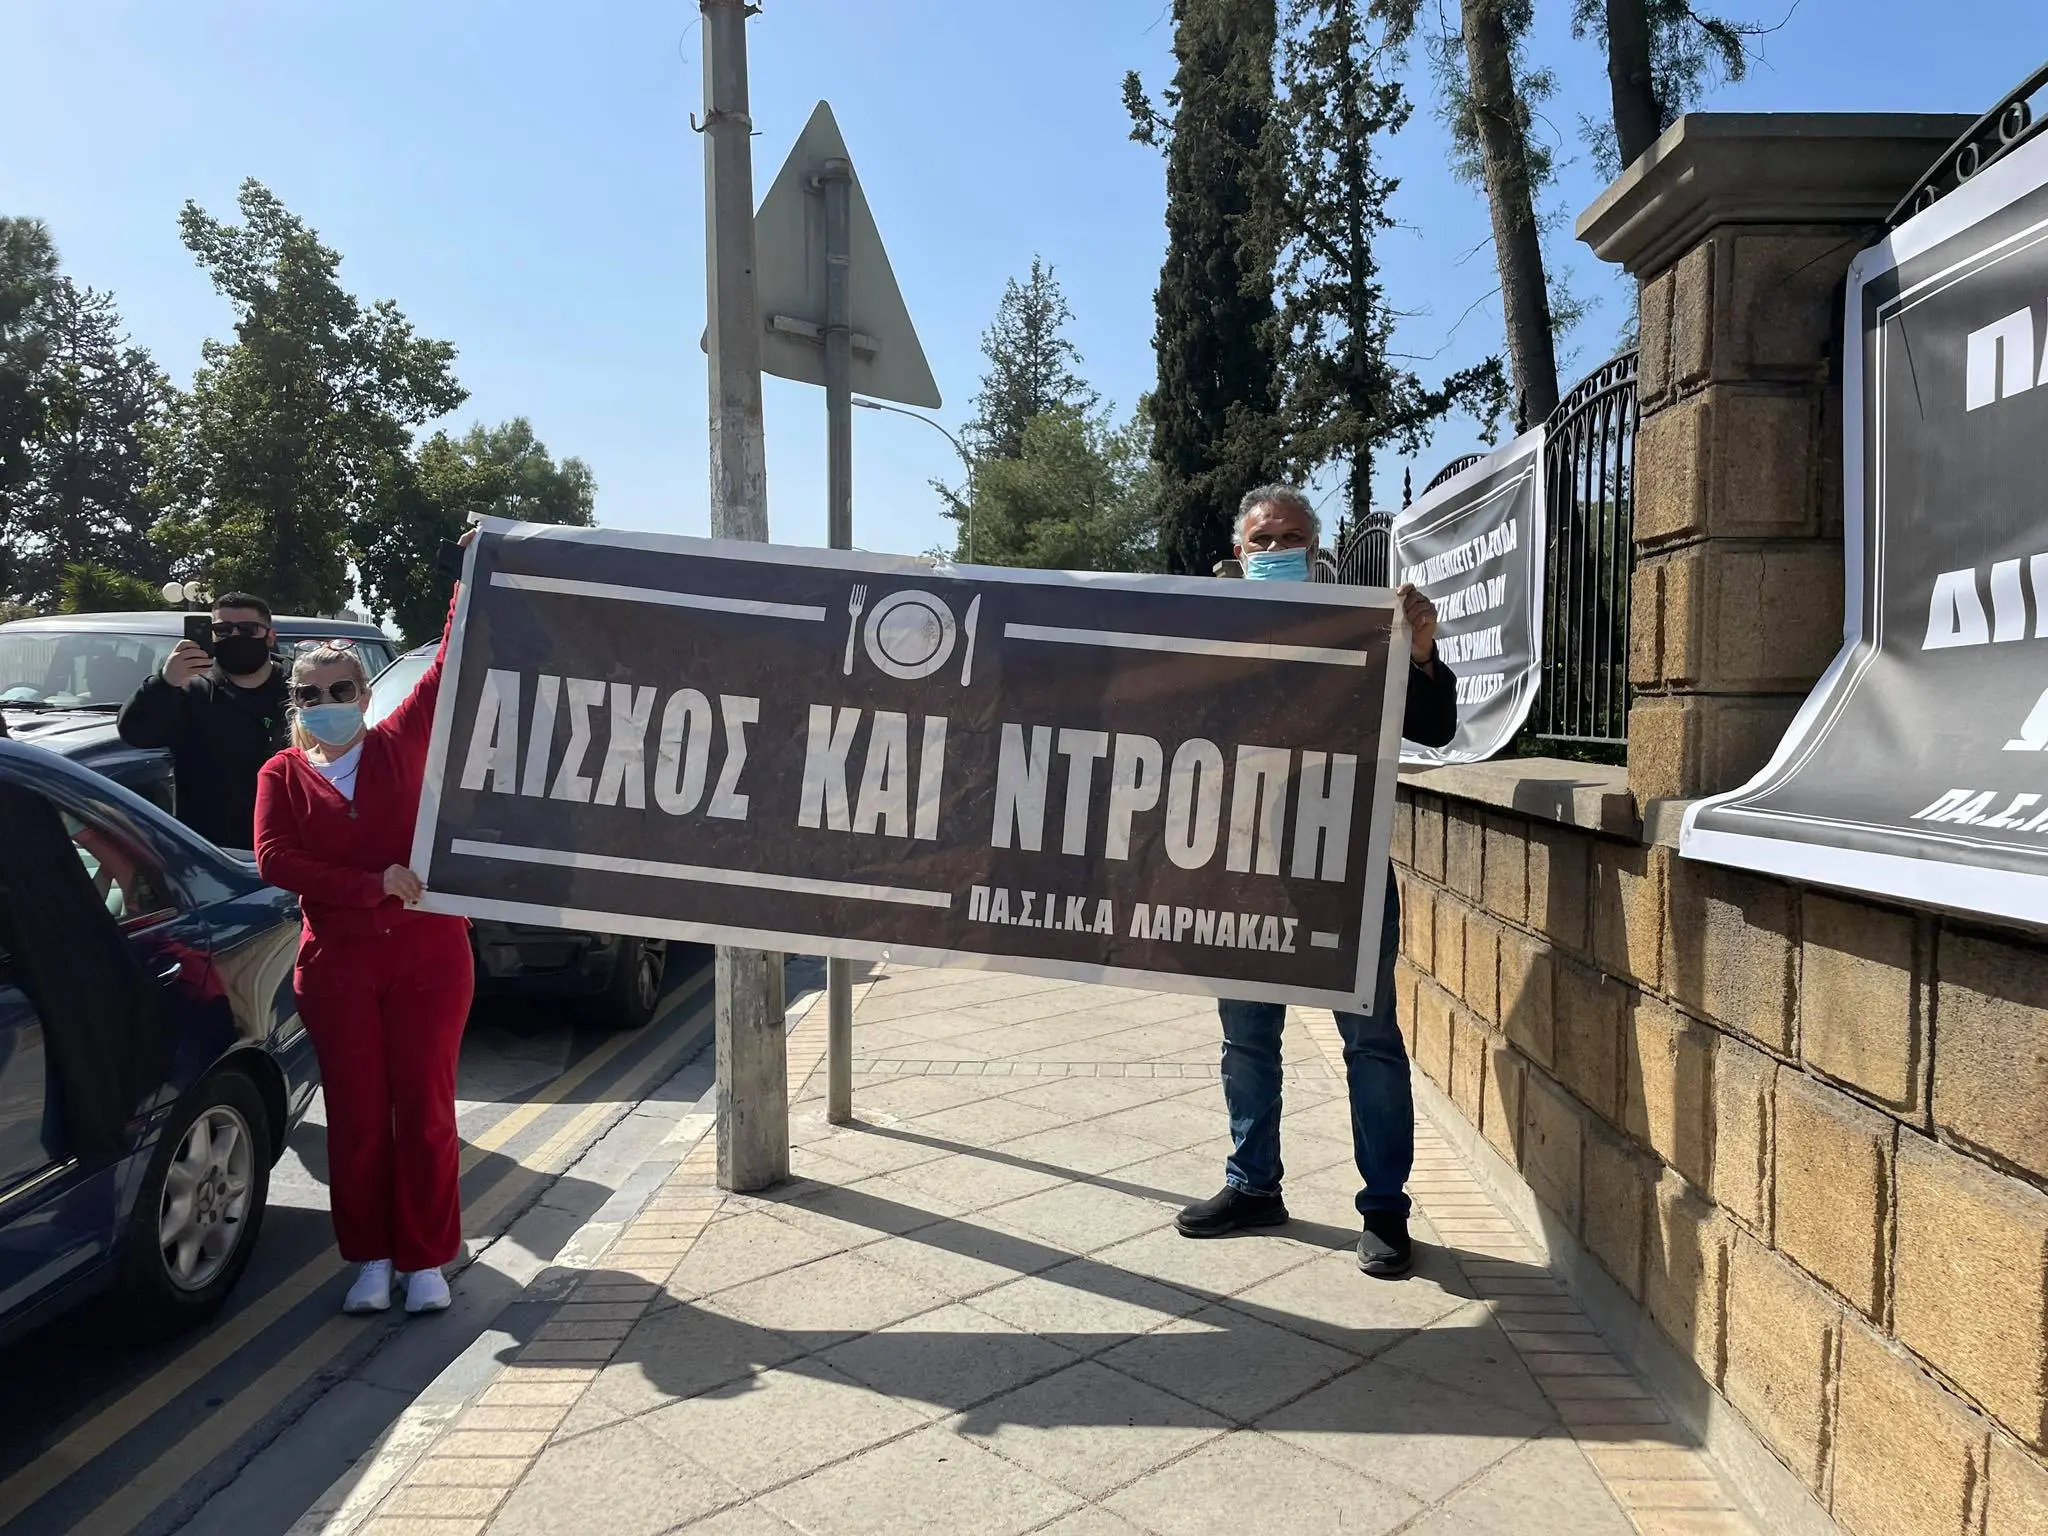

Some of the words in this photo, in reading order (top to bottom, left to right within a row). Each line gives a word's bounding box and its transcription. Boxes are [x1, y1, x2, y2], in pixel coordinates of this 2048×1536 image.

[1465, 581, 1487, 616] ΑΠΟ
[1486, 573, 1507, 610] ΠΟΥ
[459, 668, 761, 822] ΑΙΣΧΟΣ
[797, 704, 948, 841] ΚΑΙ
[991, 722, 1358, 883] ΝΤΡΟΠΗ
[968, 884, 1114, 936] ΠΑ.Σ.Ι.Κ.Α
[1128, 903, 1299, 954] ΛΑΡΝΑΚΑΣ
